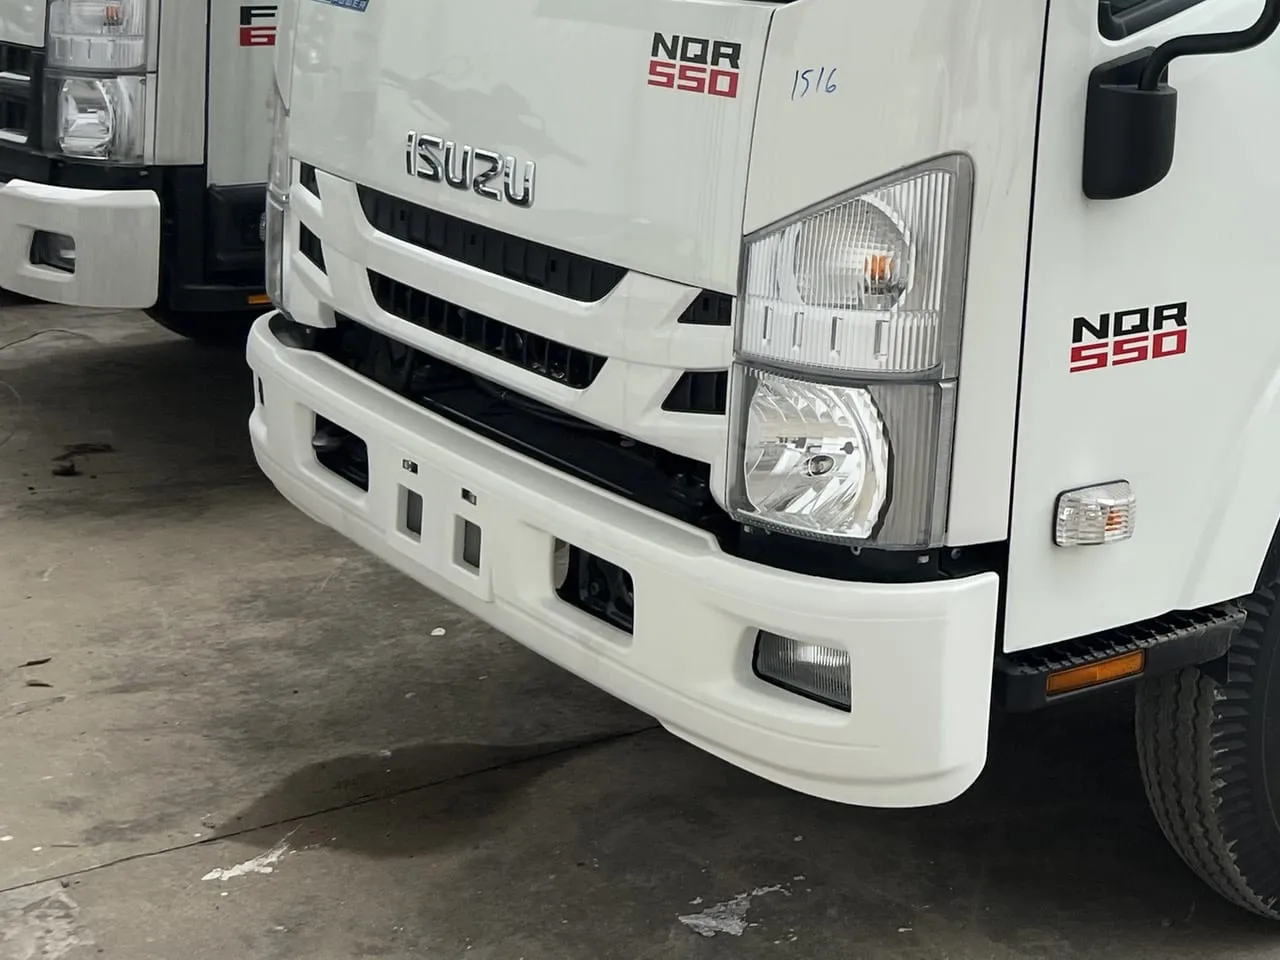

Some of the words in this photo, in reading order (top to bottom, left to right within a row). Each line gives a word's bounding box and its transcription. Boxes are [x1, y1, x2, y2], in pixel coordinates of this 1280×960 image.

[651, 32, 742, 69] NQR
[648, 59, 739, 98] 550
[791, 66, 838, 101] 1516
[406, 129, 537, 209] ISUZU
[1072, 301, 1188, 344] NQR
[1070, 329, 1187, 373] 550
